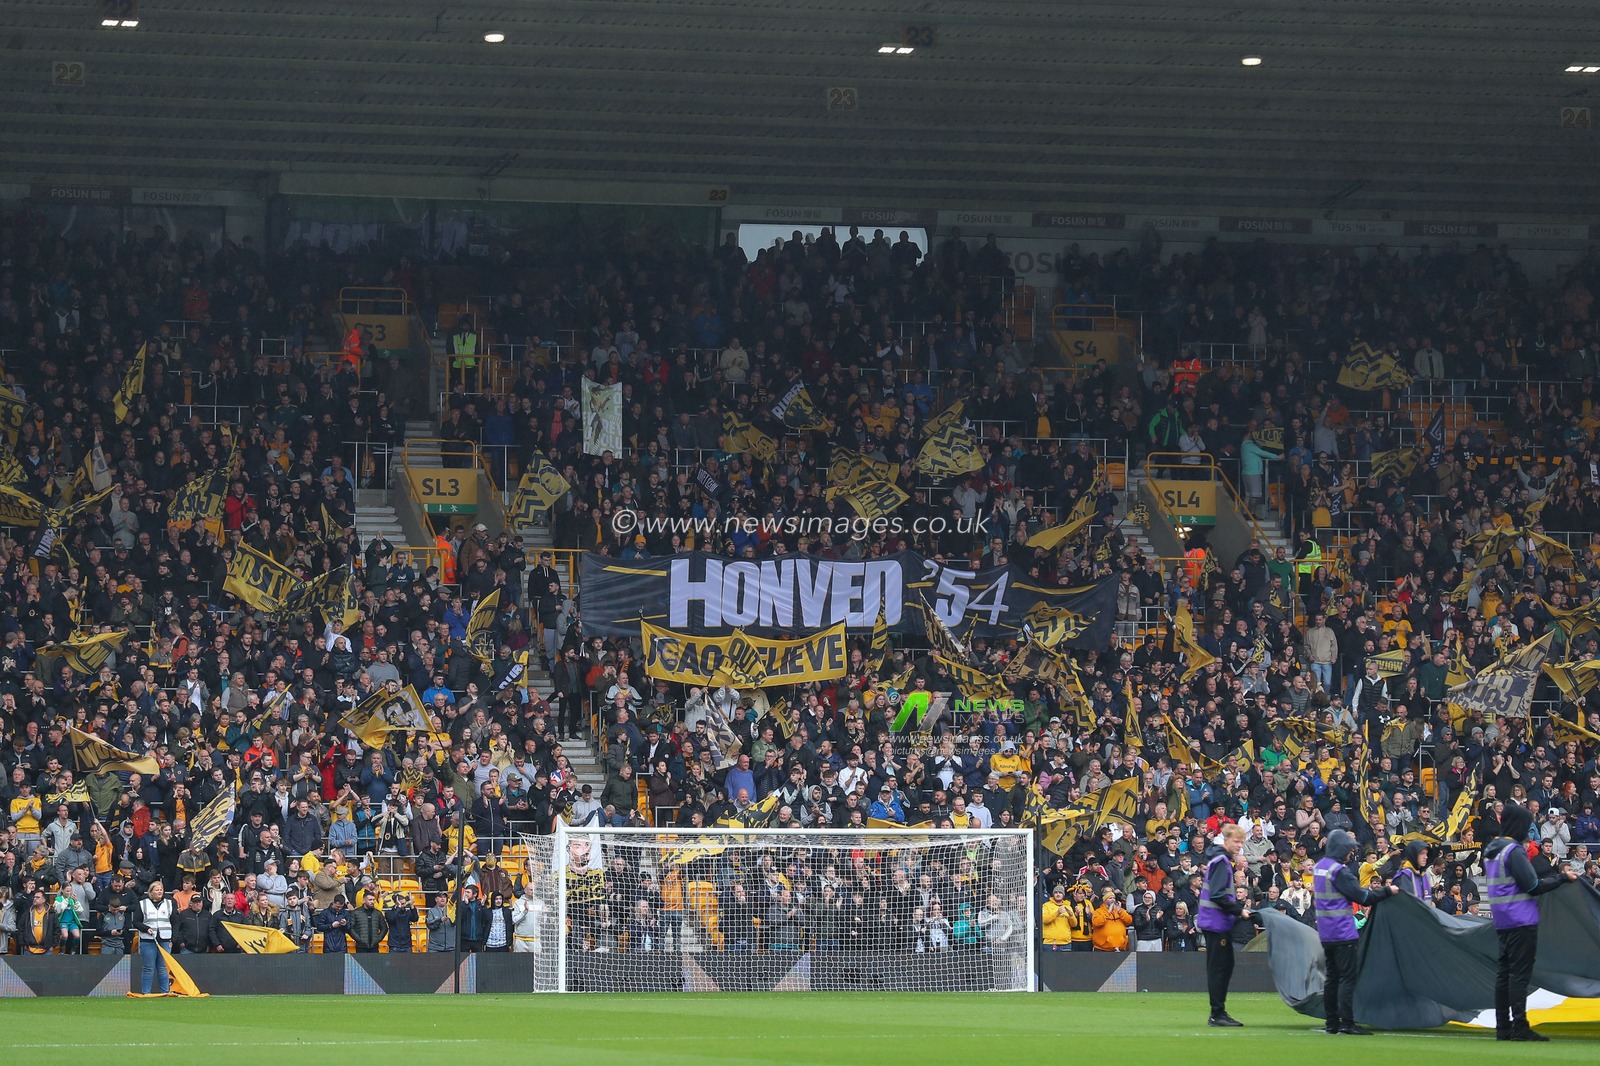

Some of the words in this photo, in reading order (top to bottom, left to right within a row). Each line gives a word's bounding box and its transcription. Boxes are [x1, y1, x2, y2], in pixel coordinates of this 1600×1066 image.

[55, 63, 83, 84] 22
[829, 88, 856, 110] 23
[1562, 108, 1590, 129] 24
[50, 188, 89, 200] FOSUN
[142, 191, 180, 201] FOSUN
[709, 190, 728, 201] 23
[765, 208, 801, 218] FOSUN
[862, 210, 897, 221] FOSUN
[956, 214, 992, 224] FOSUN
[1051, 216, 1086, 226] FOSUN
[1145, 219, 1180, 230] OSUN
[1238, 220, 1273, 230] FOSUN
[1423, 223, 1458, 234] FOSUN
[1073, 340, 1097, 358] S4
[421, 477, 461, 498] SL3
[1163, 489, 1200, 509] SL4
[669, 558, 903, 628] HONVED
